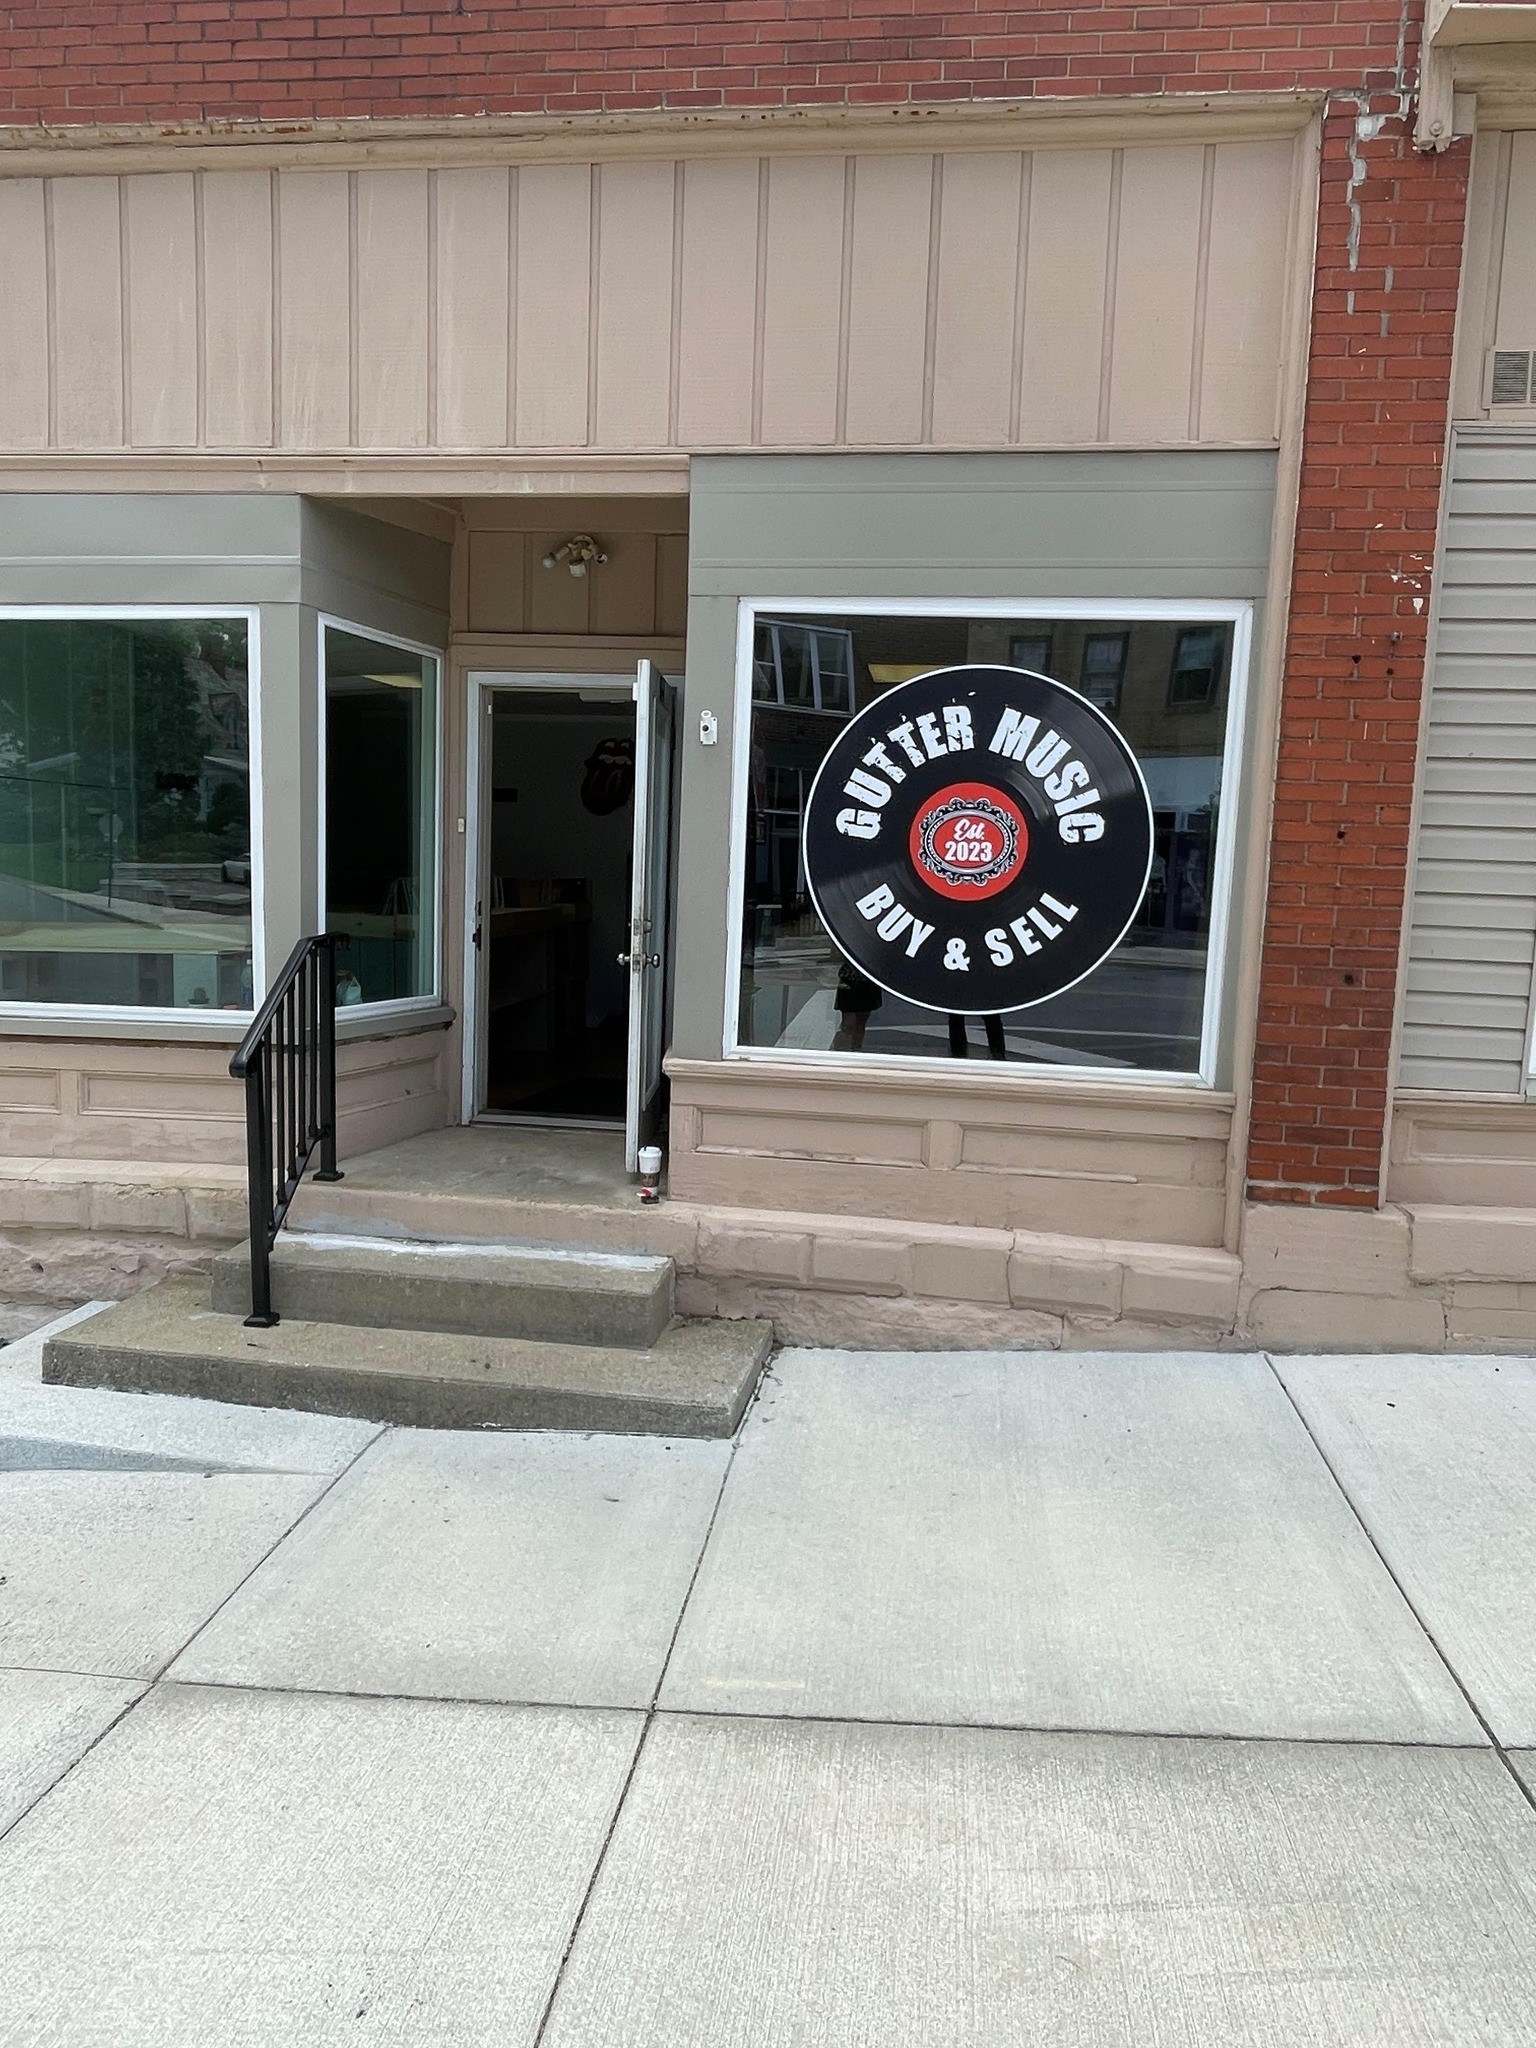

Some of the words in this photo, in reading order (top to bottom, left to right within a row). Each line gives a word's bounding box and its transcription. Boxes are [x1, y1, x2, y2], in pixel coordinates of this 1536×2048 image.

[836, 705, 974, 840] GUTTER
[988, 707, 1105, 844] MUSIC
[945, 841, 992, 863] 2023
[954, 818, 985, 841] Est.
[855, 883, 935, 958] BUY
[943, 937, 970, 971] &
[984, 892, 1079, 967] SELL
